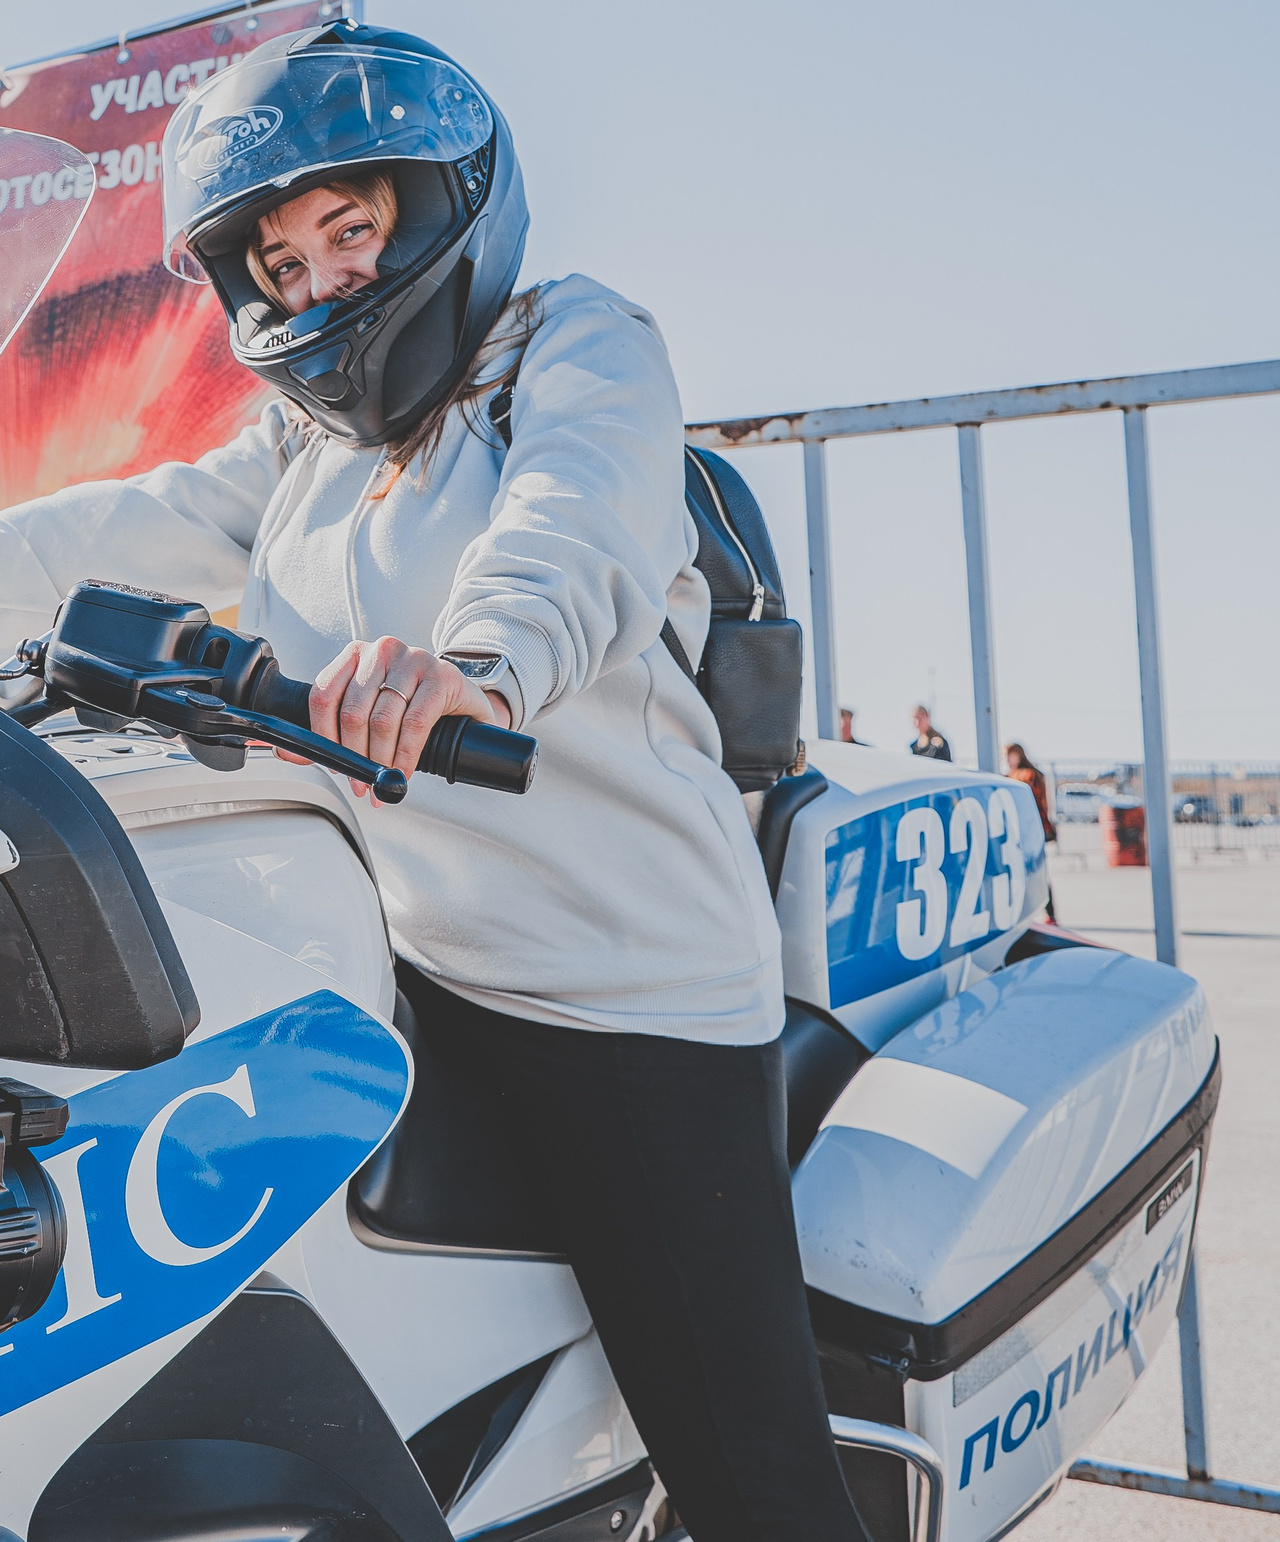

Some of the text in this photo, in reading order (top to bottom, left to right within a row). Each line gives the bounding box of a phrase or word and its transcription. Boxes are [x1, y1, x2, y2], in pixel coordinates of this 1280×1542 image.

[896, 787, 1026, 961] 323
[1157, 1177, 1186, 1218] BMW
[958, 1229, 1184, 1491] ПОЛИЦИЯ
